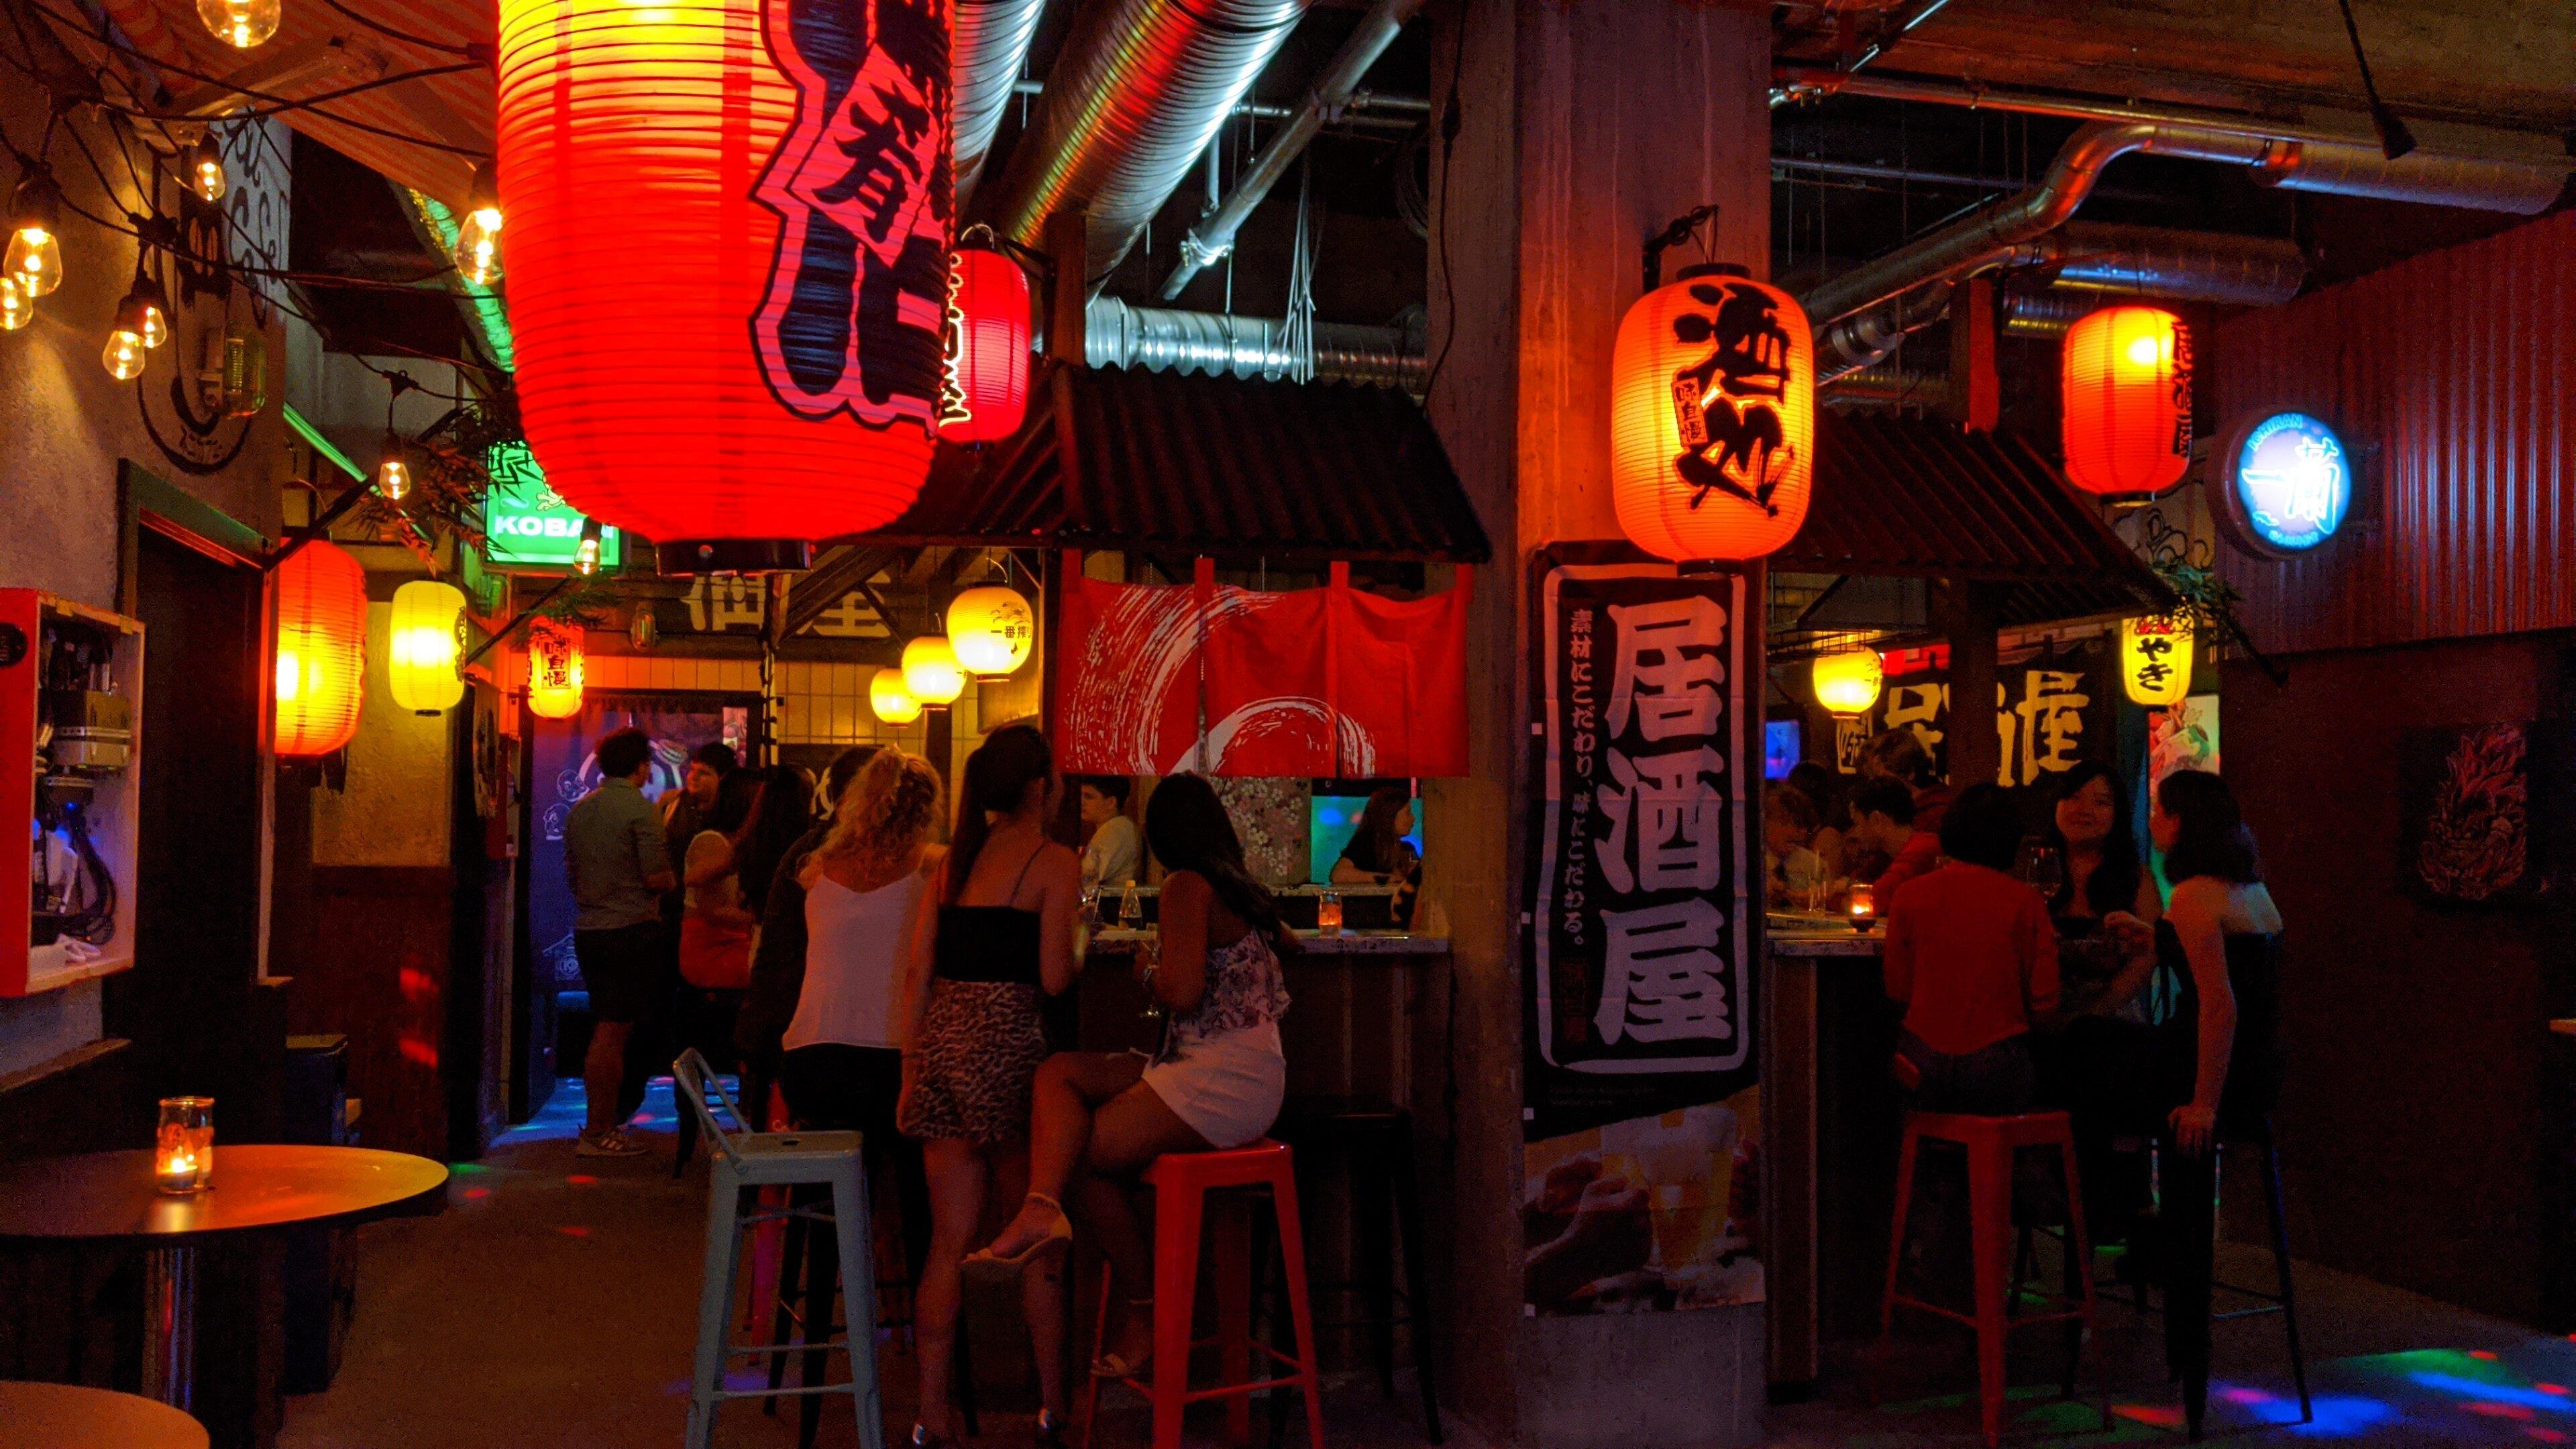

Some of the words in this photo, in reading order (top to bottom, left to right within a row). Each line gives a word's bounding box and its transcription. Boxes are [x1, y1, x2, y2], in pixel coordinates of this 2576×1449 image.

[2247, 412, 2303, 451] ICHIRAN
[494, 515, 614, 539] KOBA
[1593, 594, 1732, 1045] 居酒屋
